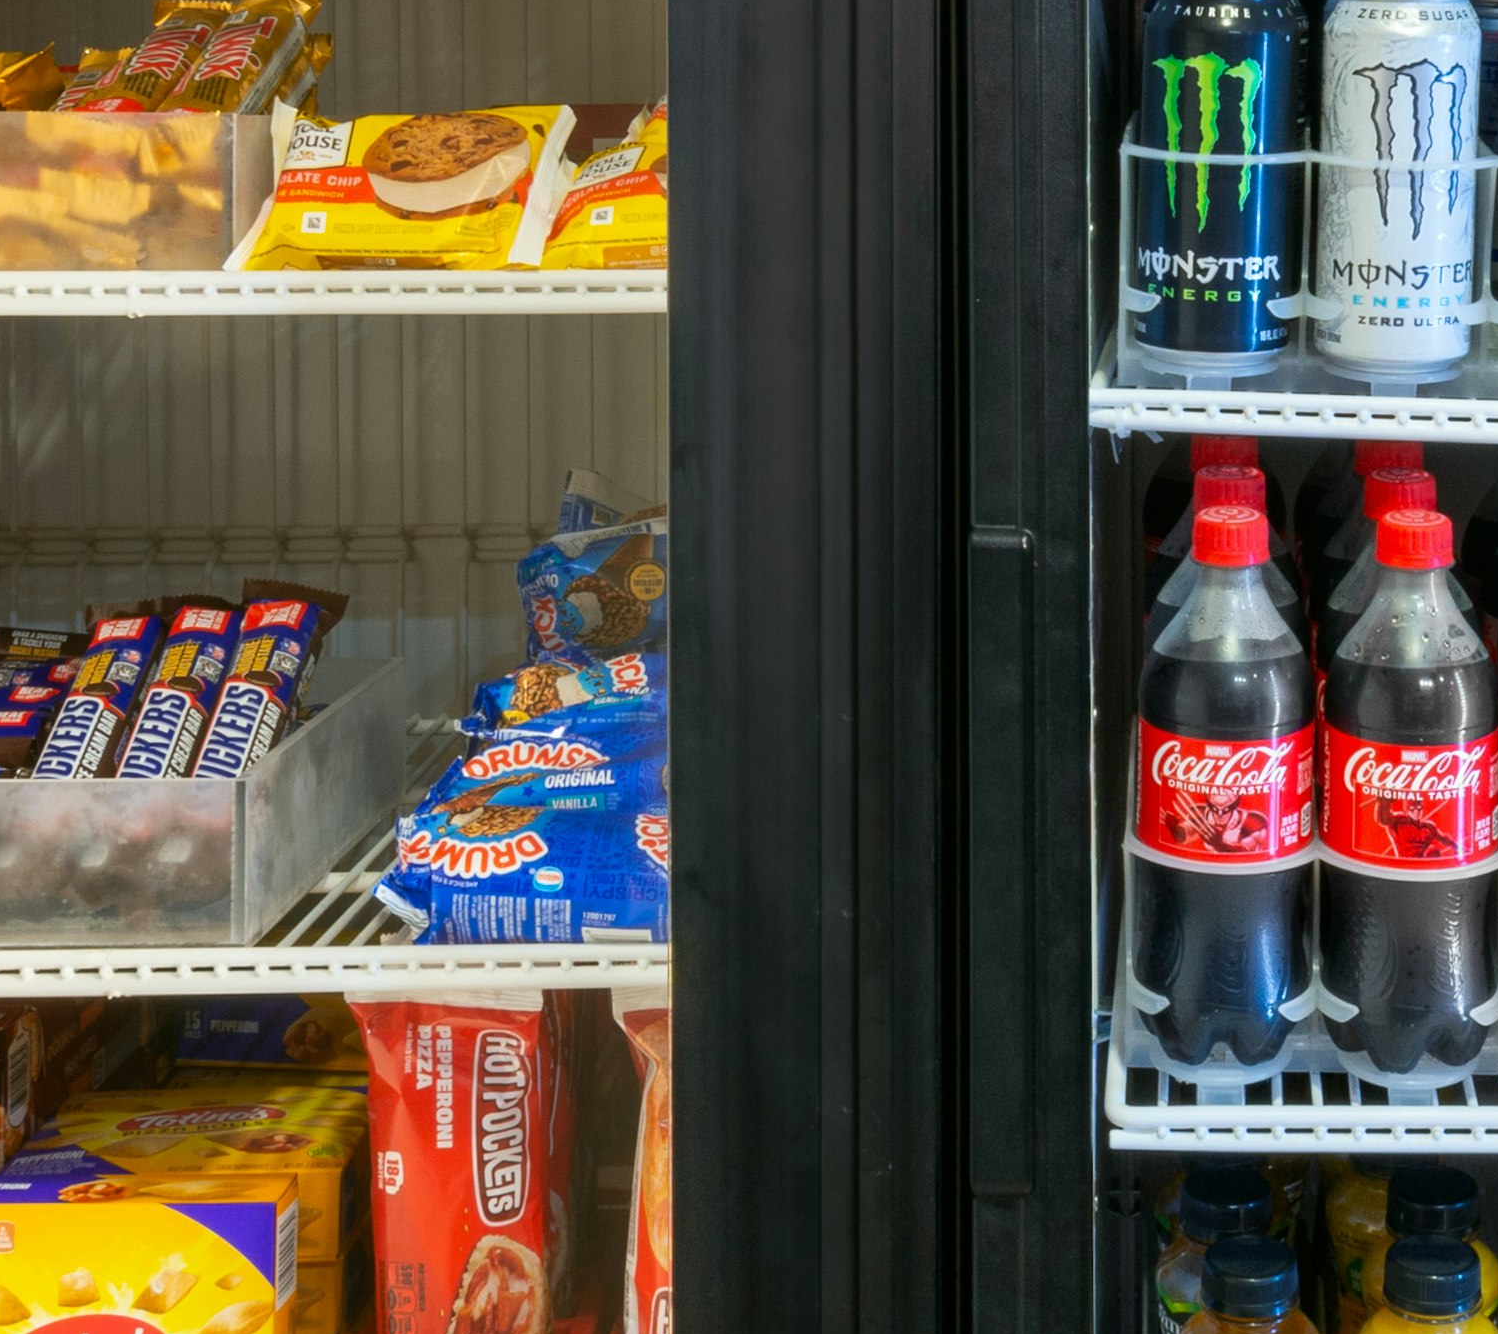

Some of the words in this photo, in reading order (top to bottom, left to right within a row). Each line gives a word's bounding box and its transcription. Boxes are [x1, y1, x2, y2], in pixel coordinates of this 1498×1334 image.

[1136, 248, 1280, 283] MONSTER
[1332, 257, 1472, 288] MONSTER
[1353, 293, 1465, 308] ENERGY
[1358, 316, 1403, 327] ZERO
[1414, 316, 1460, 327] ULTRA
[1151, 739, 1286, 789] Coca-Cola
[545, 771, 616, 789] ORIGINAL
[1167, 780, 1236, 793] ORIGINAL
[1239, 784, 1271, 794] TASTE
[551, 796, 598, 810] VANILLA
[415, 1026, 432, 1090] PIZZA
[436, 1026, 452, 1148] PEPPERONI
